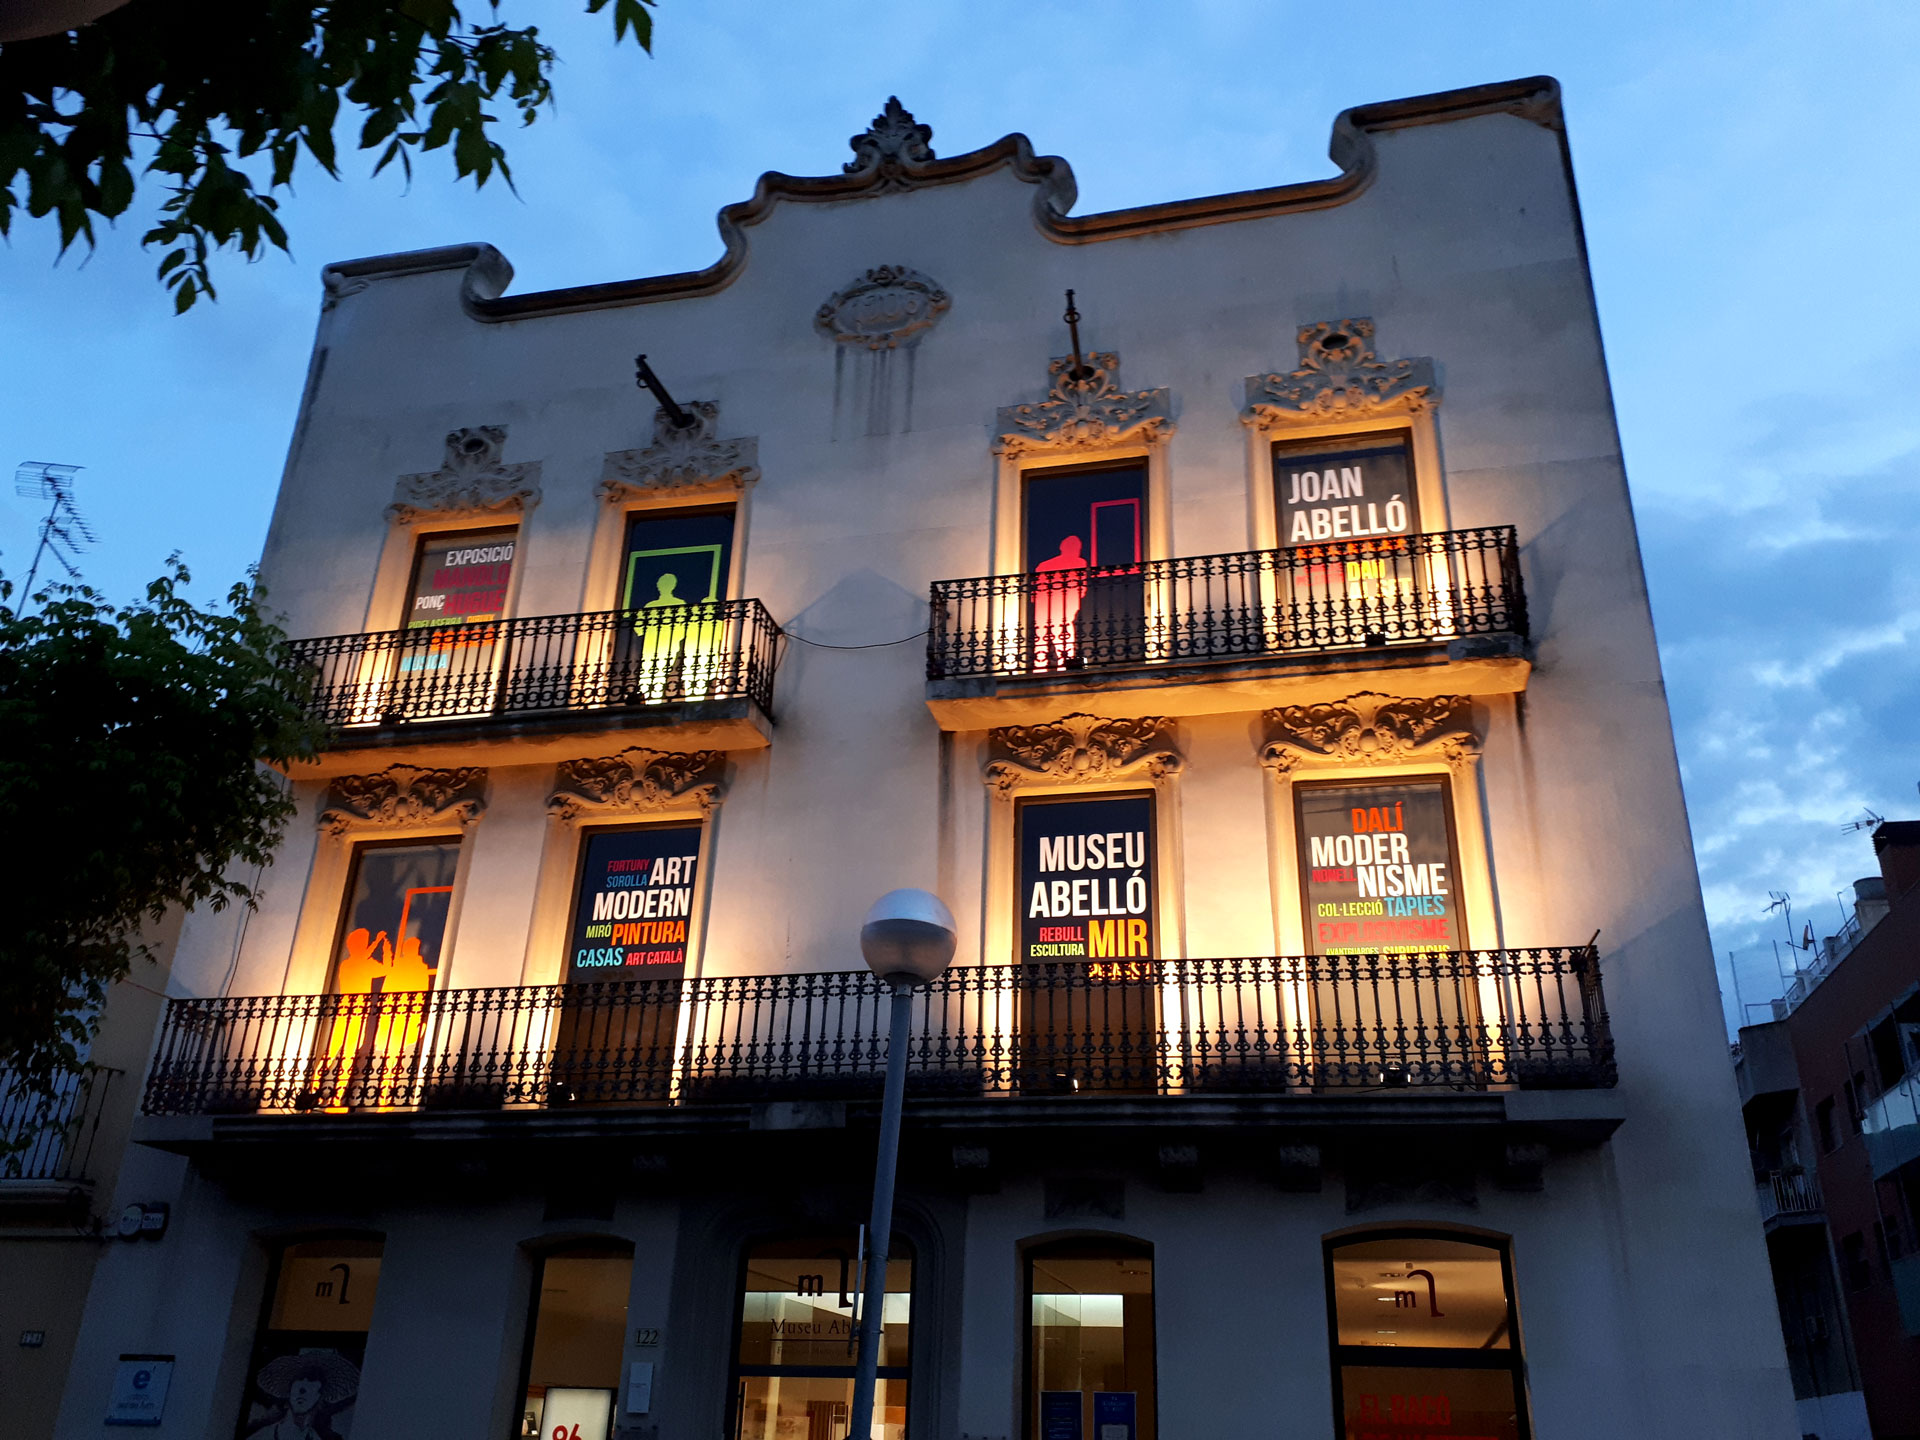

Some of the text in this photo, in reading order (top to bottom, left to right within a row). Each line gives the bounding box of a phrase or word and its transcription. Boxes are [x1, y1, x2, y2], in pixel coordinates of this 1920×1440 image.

[1288, 466, 1364, 504] JOAN
[1291, 494, 1407, 543] ABELLÓ
[445, 542, 514, 567] EXPOSICIÓ
[432, 564, 512, 590] MANOLO
[415, 594, 446, 611] PONÇ
[1351, 801, 1403, 833] DALÍ
[1039, 831, 1145, 872] MUSEU
[1310, 833, 1410, 868] MODER
[607, 859, 650, 872] FORTUNY
[649, 856, 697, 886] ART
[606, 874, 648, 888] SOROLLA
[1356, 863, 1448, 898] NISME
[592, 888, 691, 921] MODERN
[1029, 869, 1147, 919] ABELLÓ
[1317, 899, 1384, 917] COL·LECCIÓ
[586, 920, 685, 946] MIRÓ PINTURA
[1039, 926, 1085, 942] REBULL
[1088, 918, 1149, 958] MIR
[1318, 918, 1451, 944] EXPLOSIVISME
[576, 947, 683, 968] CASAS ART CATALÀ
[1030, 943, 1085, 957] ESCULTURA
[637, 1329, 658, 1344] 122
[770, 1318, 821, 1335] Museu
